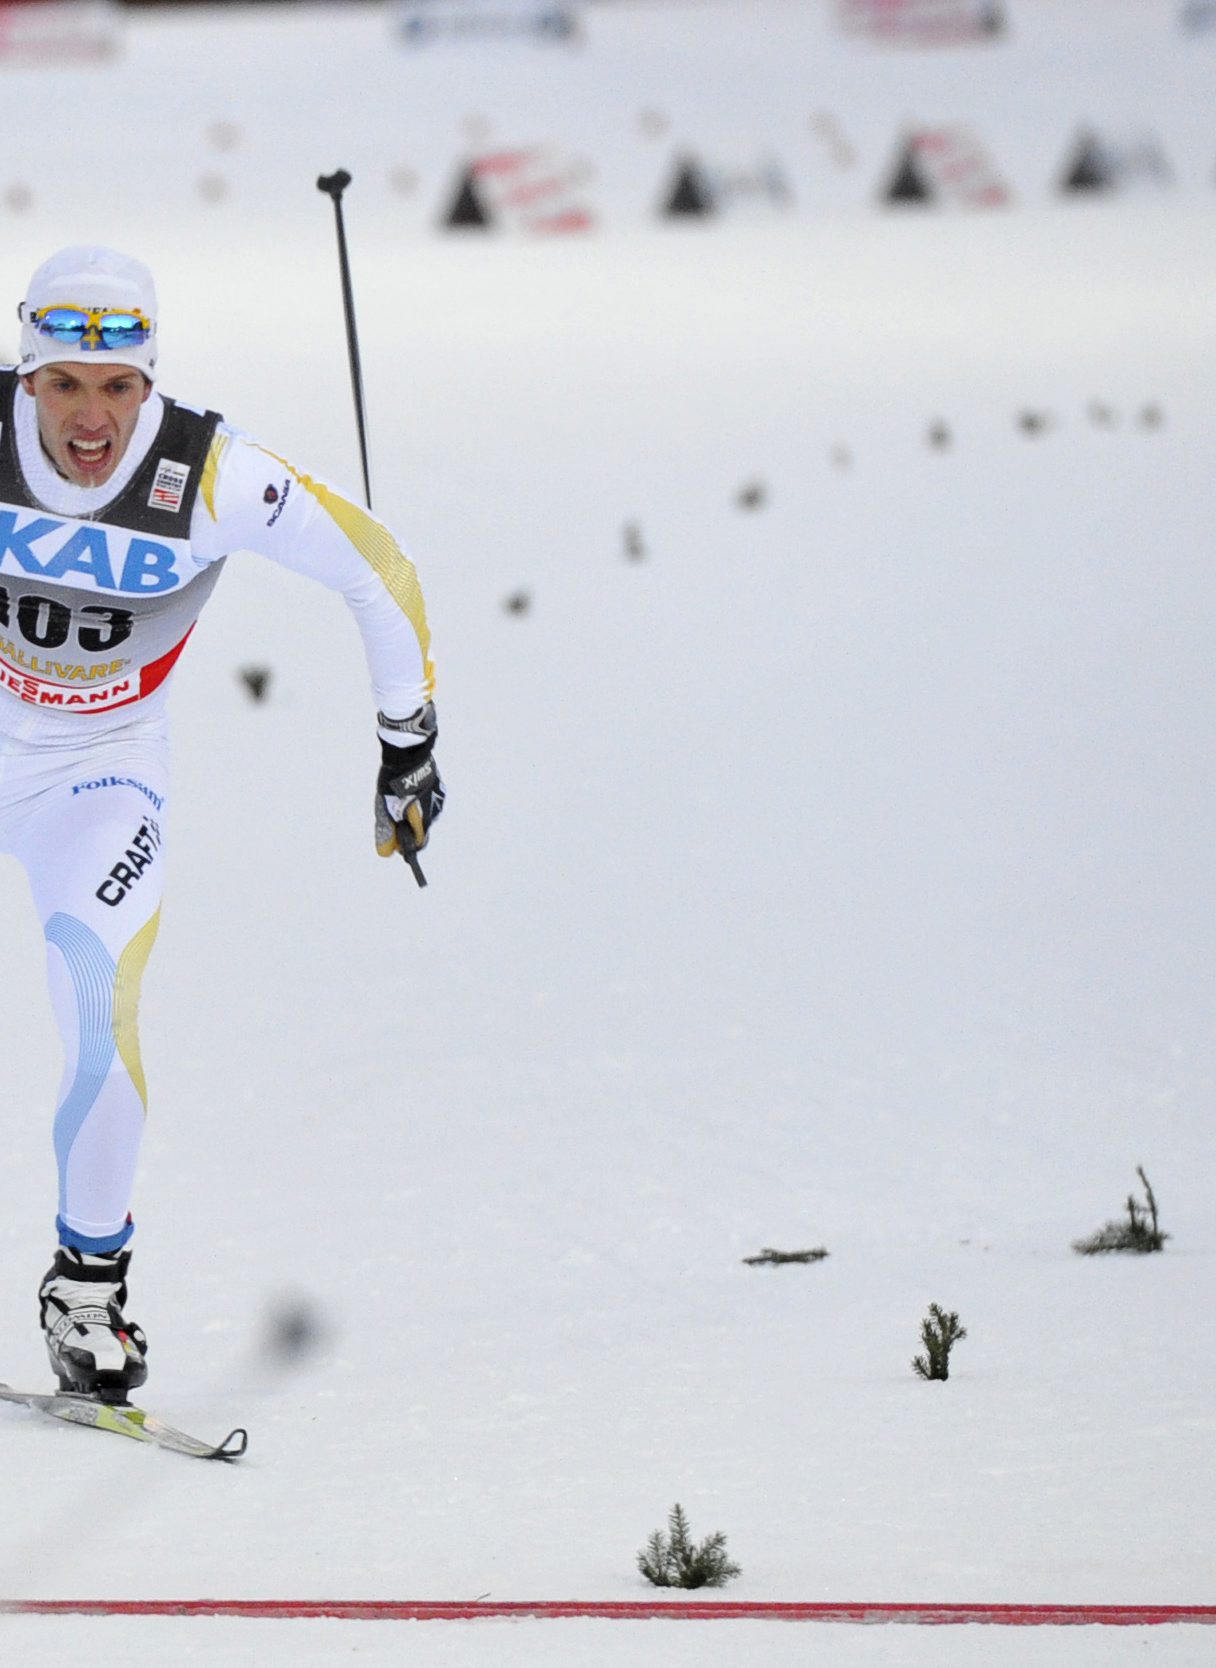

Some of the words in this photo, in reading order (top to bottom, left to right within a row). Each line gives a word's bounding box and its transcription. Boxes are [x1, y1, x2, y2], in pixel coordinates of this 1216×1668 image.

[266, 479, 291, 527] SCANIA
[71, 776, 162, 811] Folksam
[95, 823, 158, 907] CRAFT
